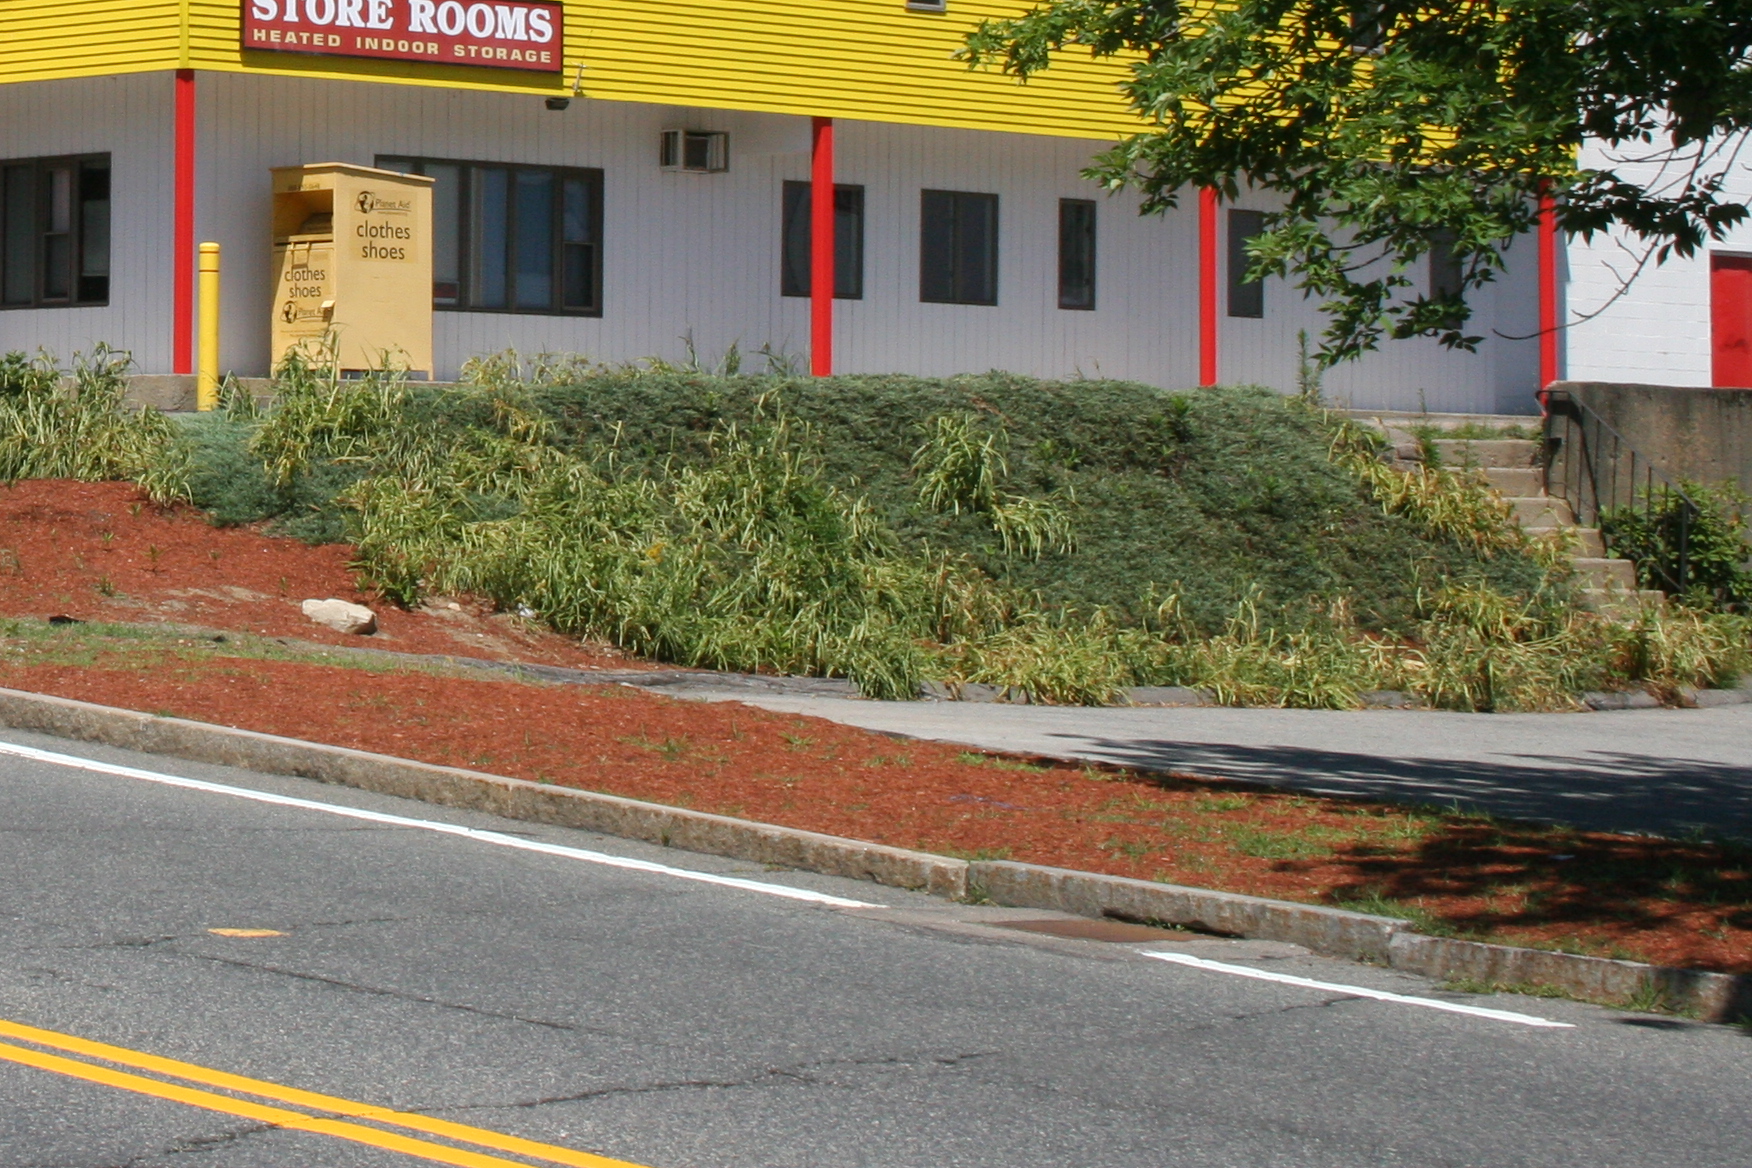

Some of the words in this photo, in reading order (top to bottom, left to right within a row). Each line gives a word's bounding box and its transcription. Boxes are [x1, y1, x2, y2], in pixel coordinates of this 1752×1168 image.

[253, 29, 341, 47] HEATED
[356, 36, 440, 54] INDOOR
[454, 45, 552, 63] STORAGE
[356, 221, 410, 239] clothes
[362, 241, 405, 260] shoes
[284, 268, 326, 281] clothes
[289, 284, 321, 298] shoes
